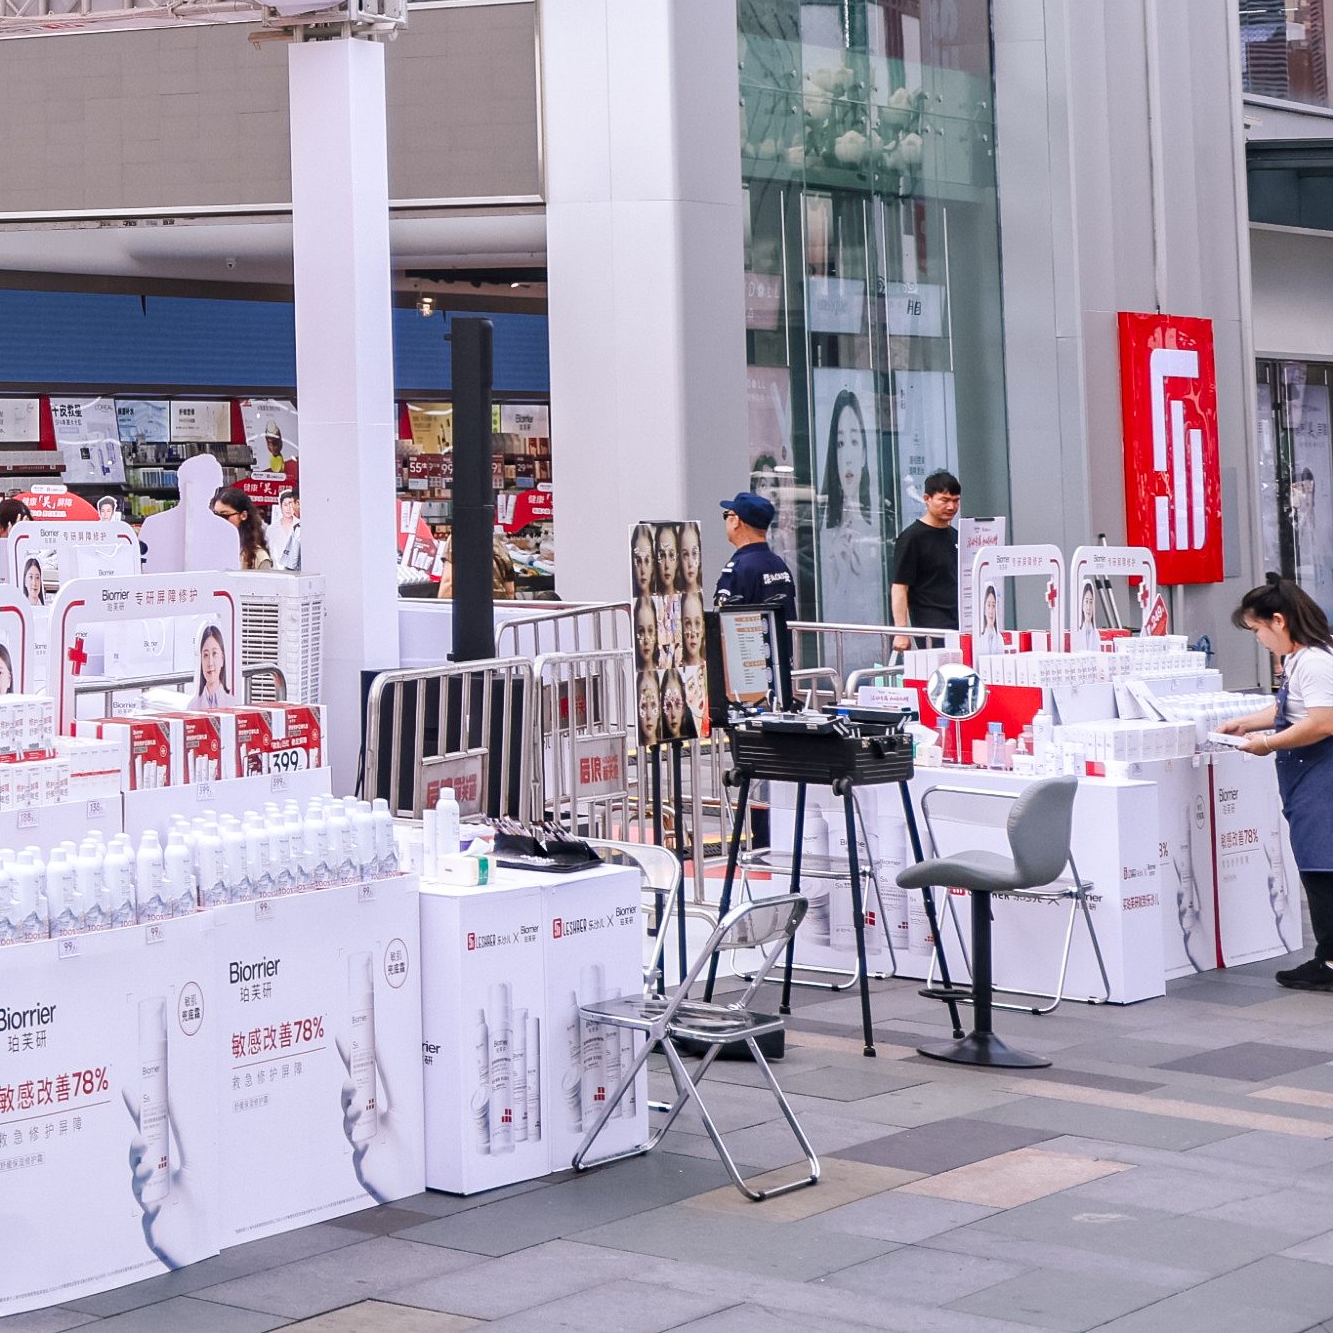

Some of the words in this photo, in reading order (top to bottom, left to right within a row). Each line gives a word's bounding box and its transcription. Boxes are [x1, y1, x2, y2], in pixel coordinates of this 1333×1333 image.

[102, 589, 130, 602] Biorrier
[135, 588, 198, 605] 专研屏障修护
[272, 749, 299, 775] 399
[1219, 788, 1240, 802] Biorrier
[616, 904, 637, 917] Biorrier
[230, 957, 280, 984] Biorrier
[240, 982, 272, 1003] 珀芙研
[8, 1030, 47, 1053] 珀芙研
[231, 1016, 325, 1059] 敏感改善78%
[232, 1062, 302, 1091] 救急修护屏障
